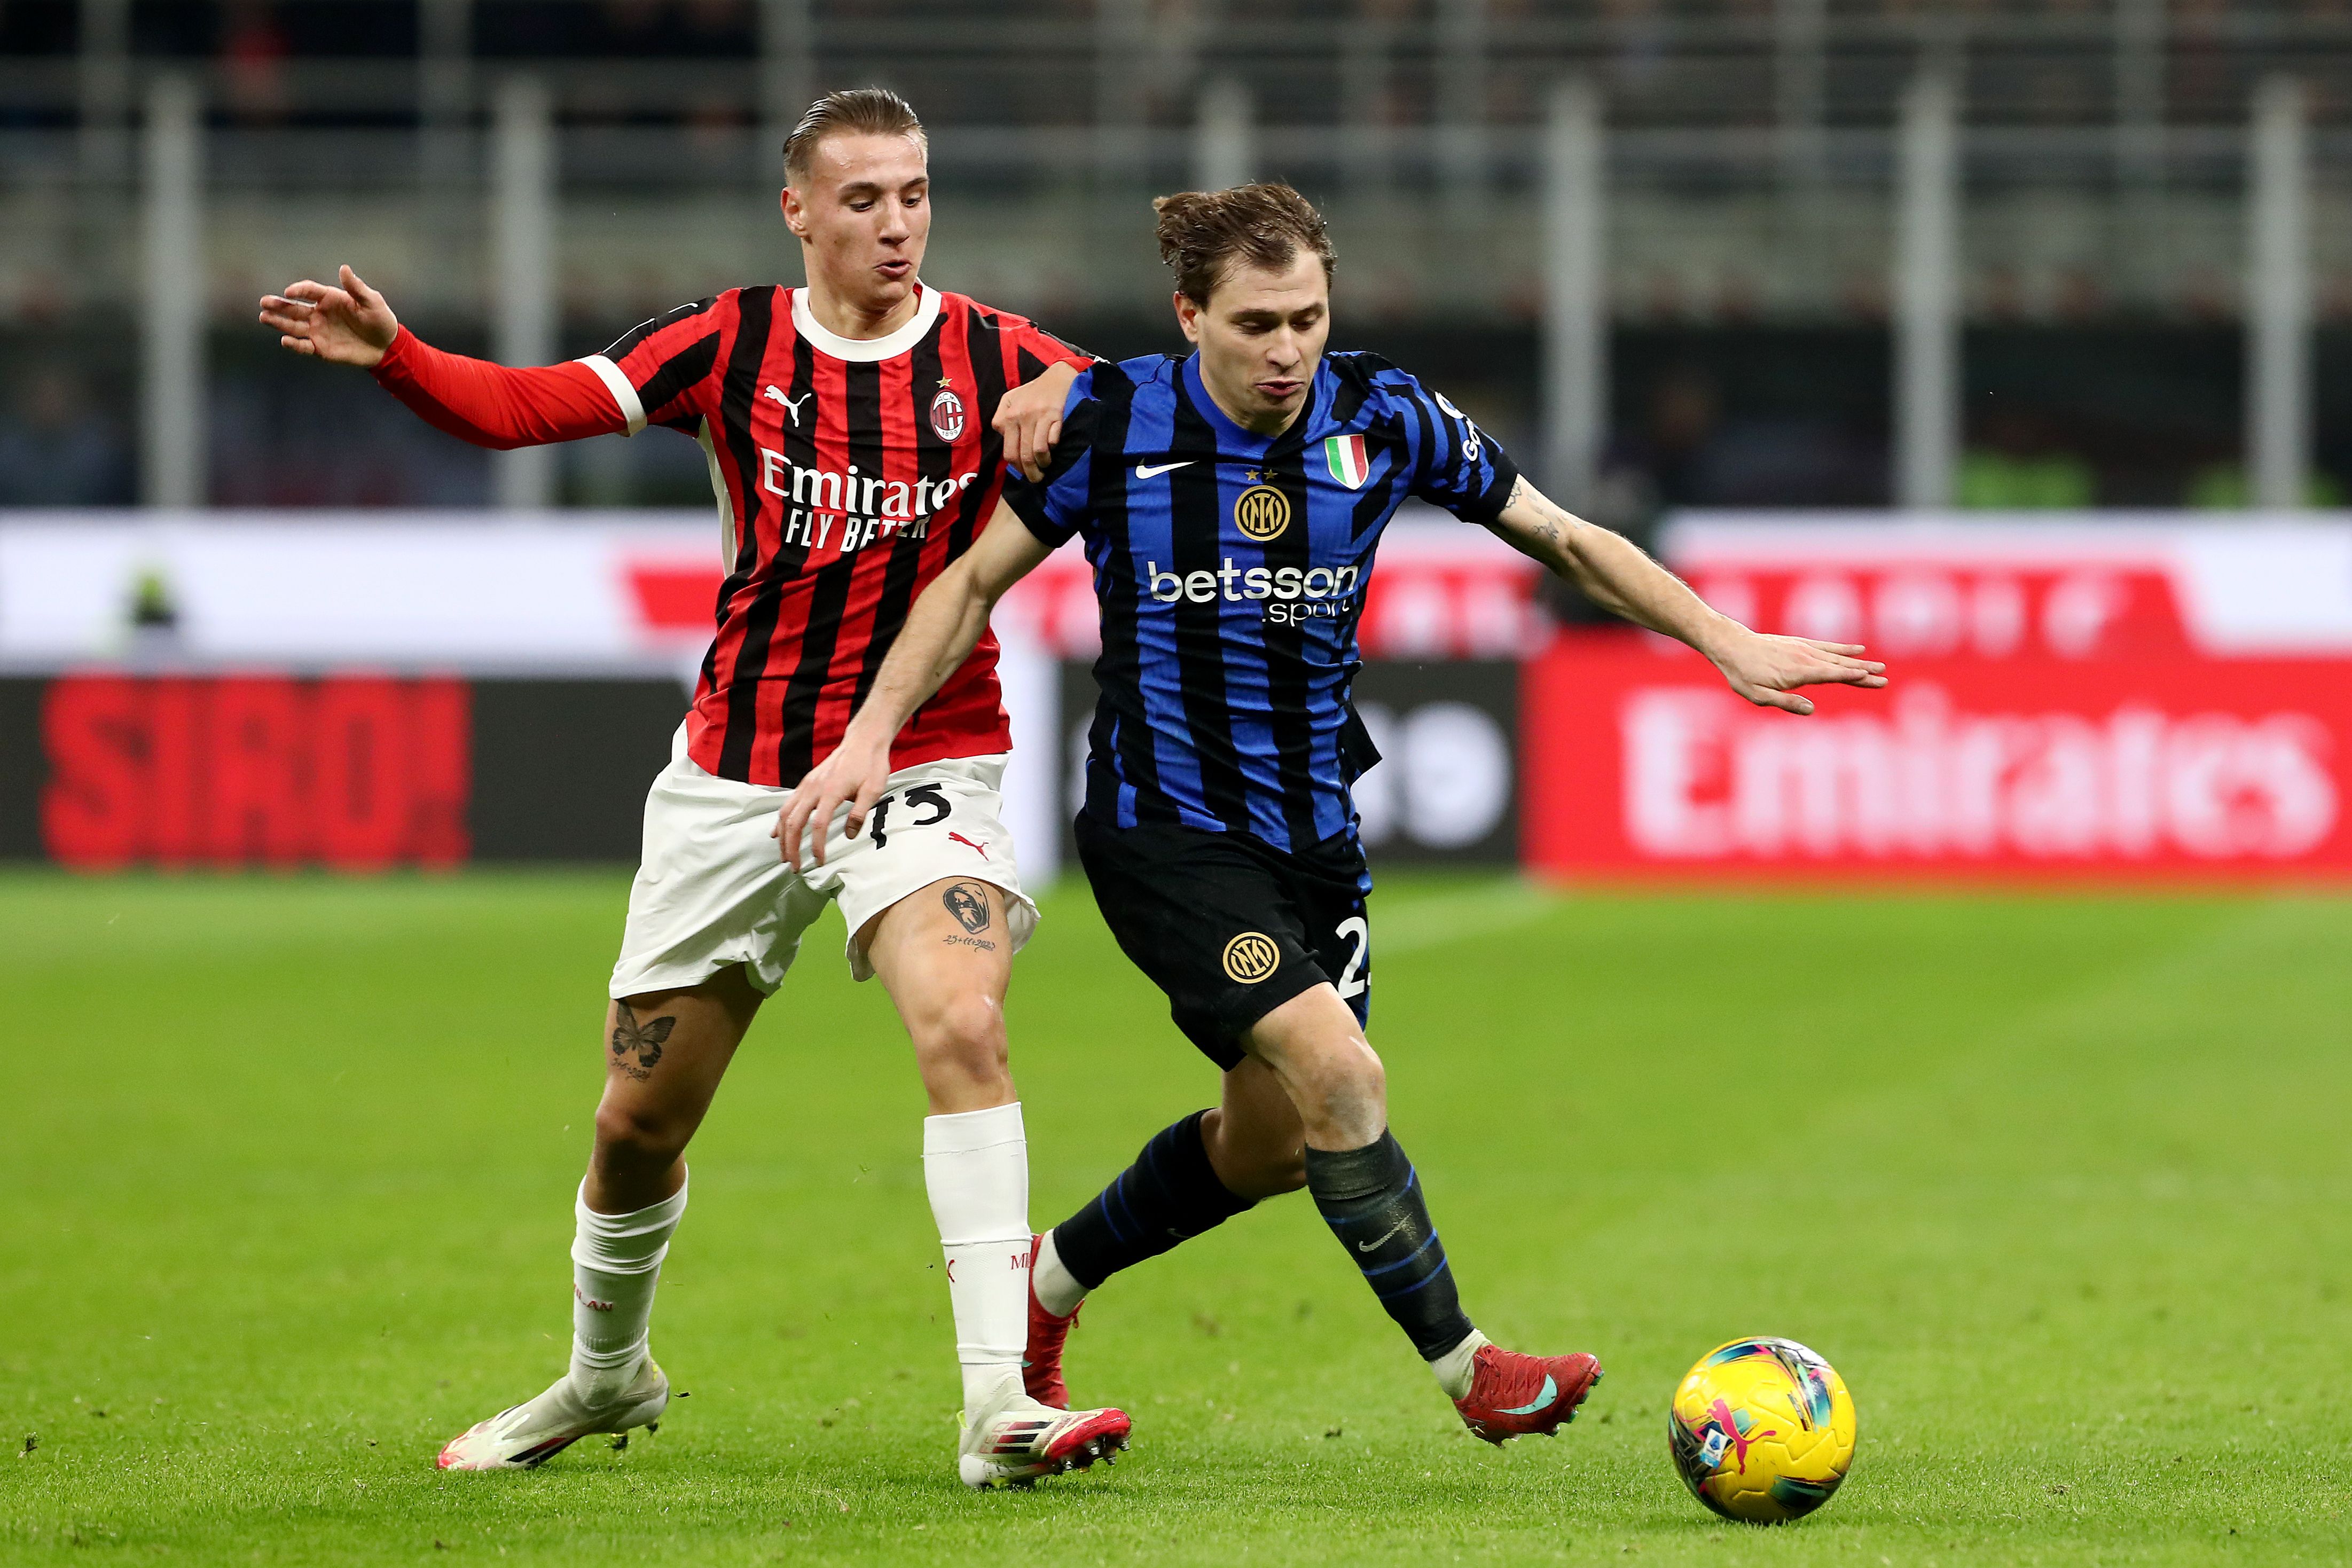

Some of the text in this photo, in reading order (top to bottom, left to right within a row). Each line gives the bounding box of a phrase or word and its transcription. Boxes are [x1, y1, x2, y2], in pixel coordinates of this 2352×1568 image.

[785, 508, 835, 550] FLY
[1147, 557, 1359, 603] betsson
[1621, 681, 2337, 860] Emirates
[1335, 916, 1371, 999] 2
